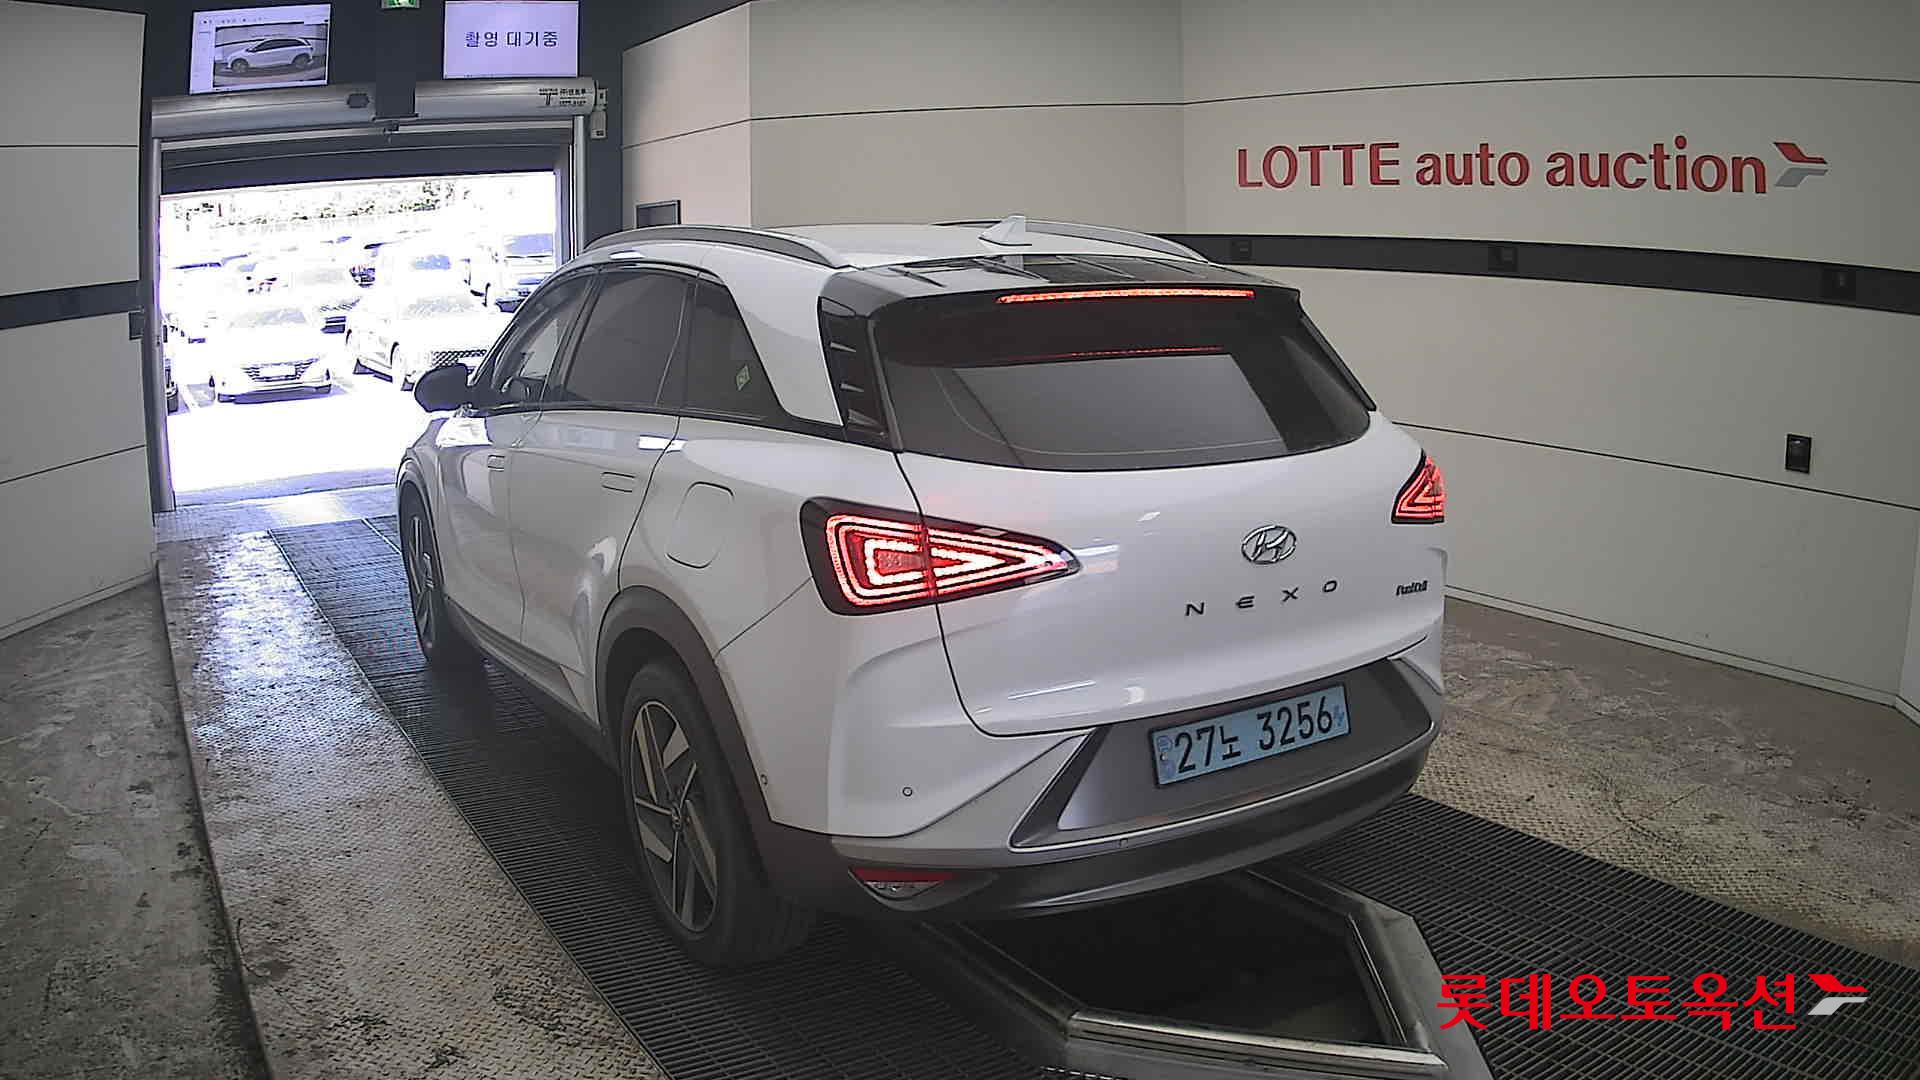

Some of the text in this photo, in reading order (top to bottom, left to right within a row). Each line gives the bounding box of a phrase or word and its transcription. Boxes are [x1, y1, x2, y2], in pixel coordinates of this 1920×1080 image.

[506, 31, 558, 48] 대기중
[1237, 135, 1766, 194] LOTTE auto auction
[1175, 696, 1333, 773] 27노 3256
